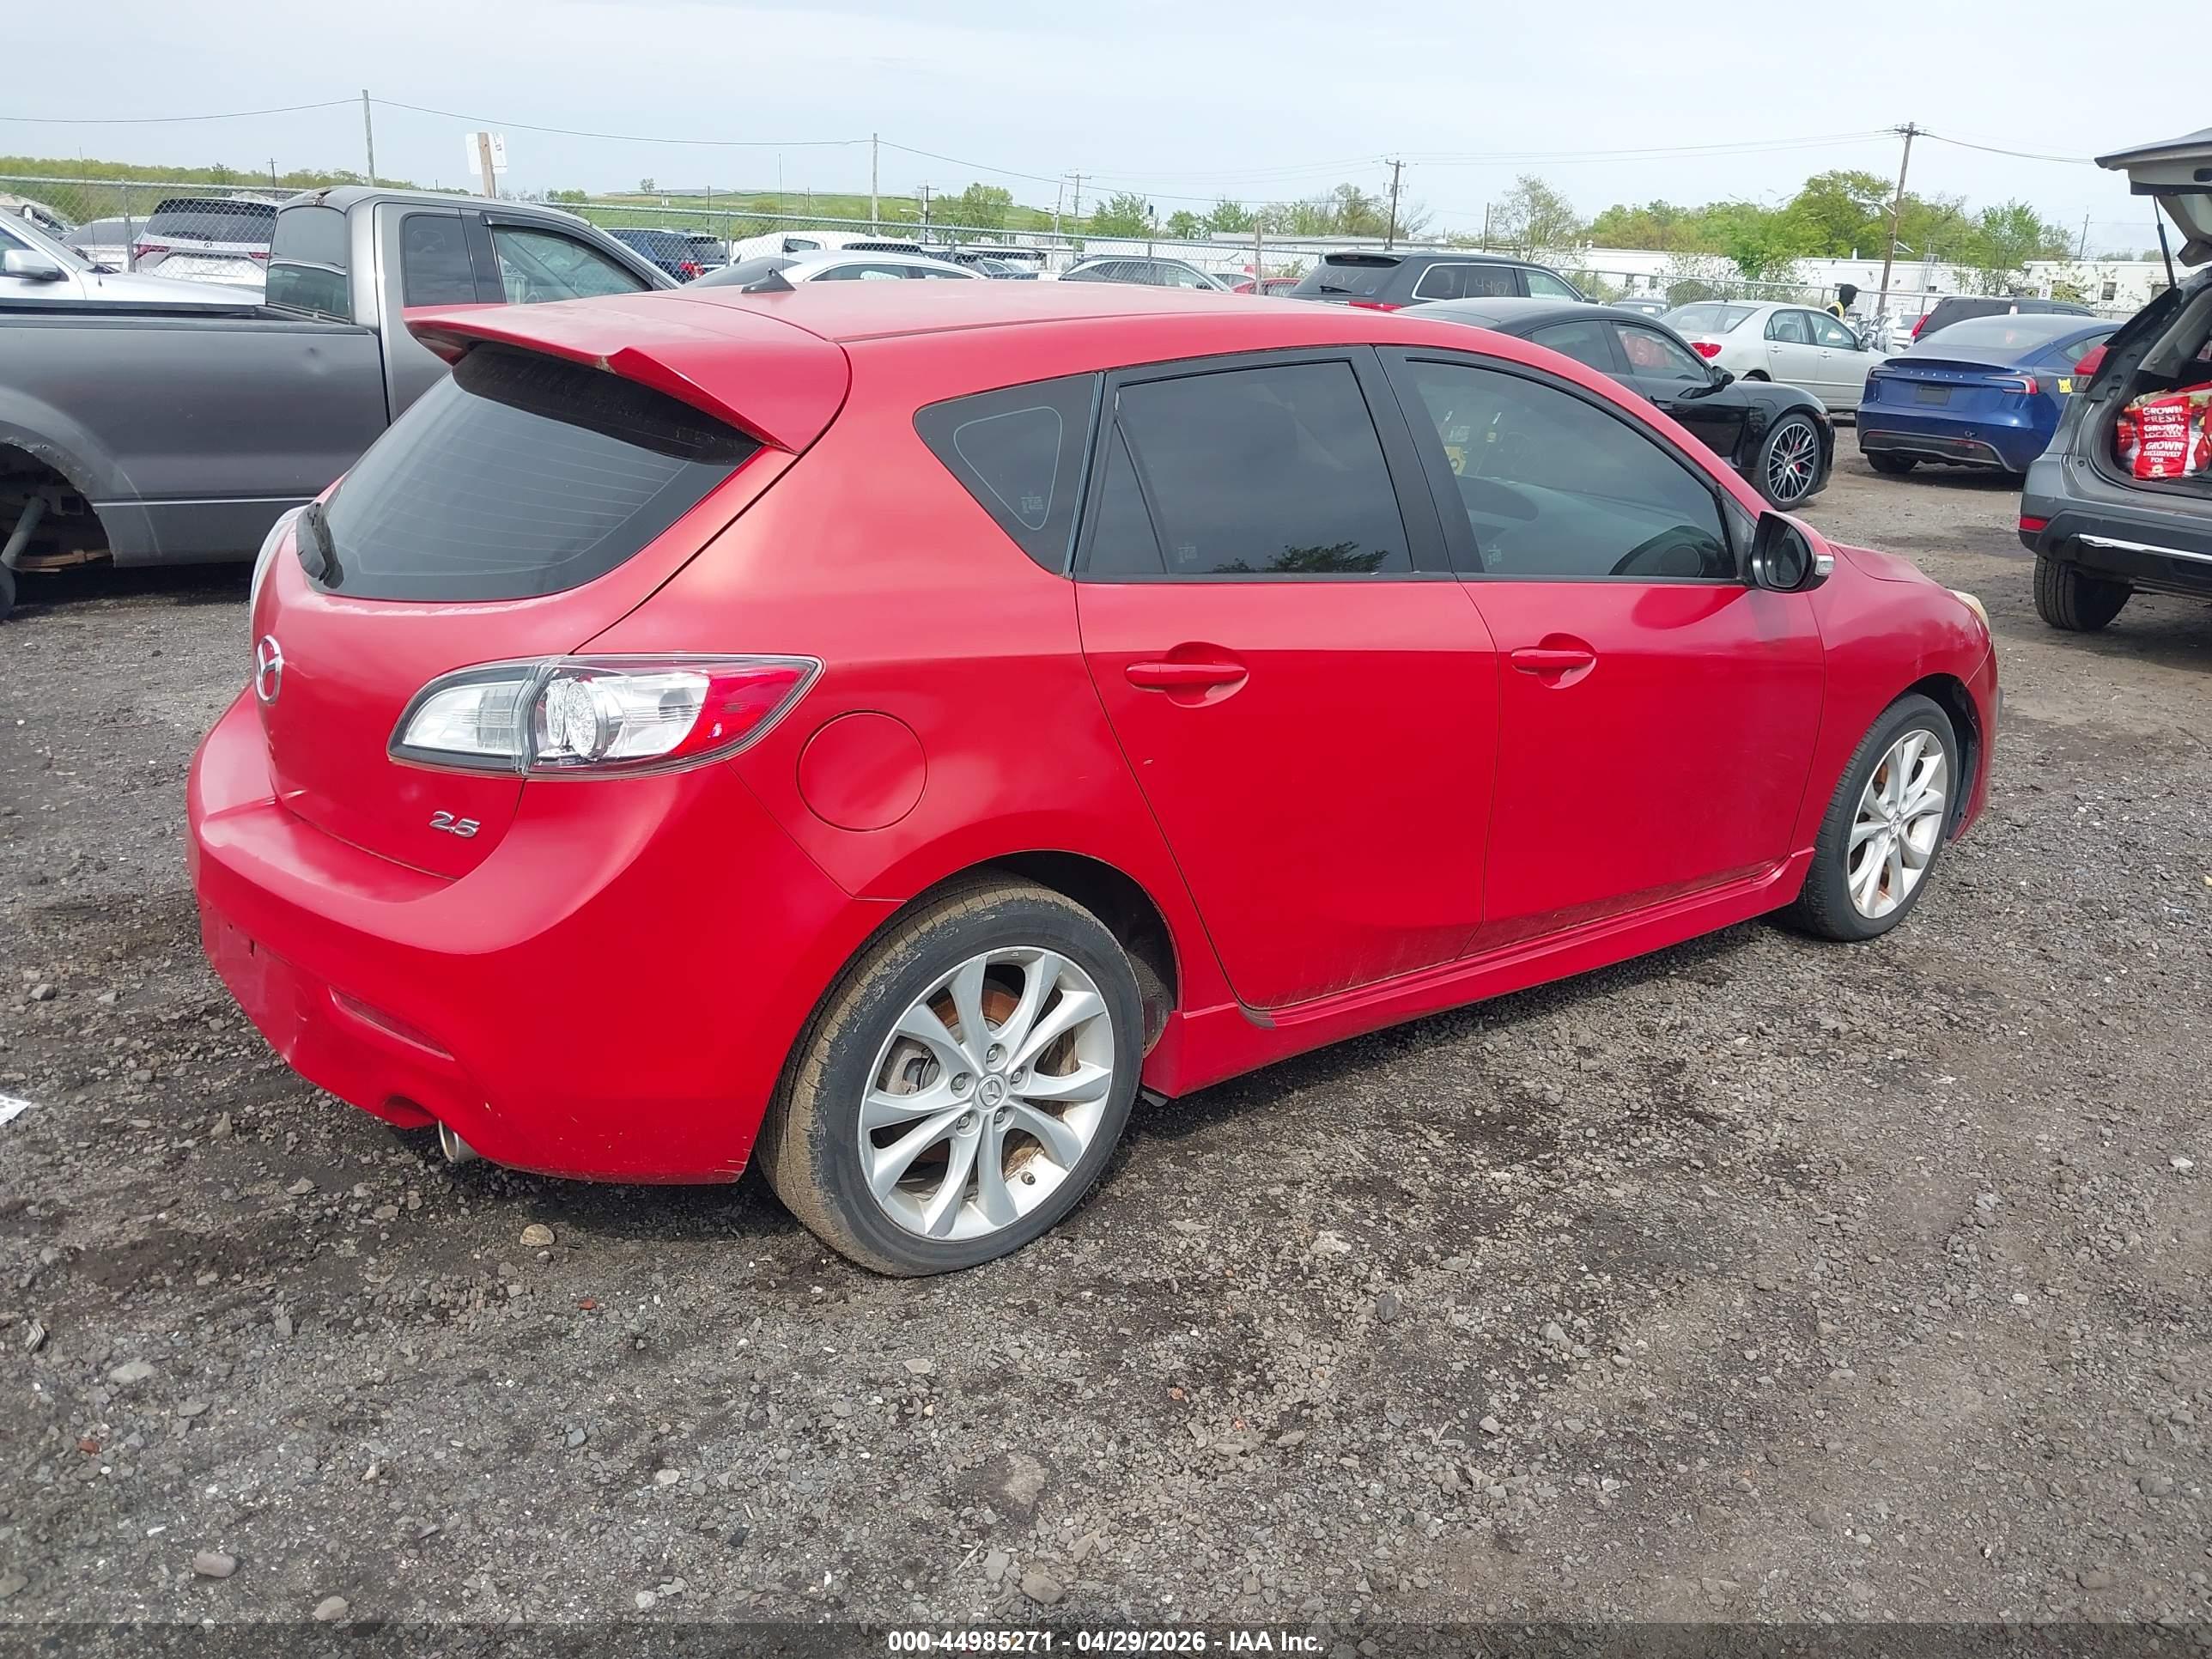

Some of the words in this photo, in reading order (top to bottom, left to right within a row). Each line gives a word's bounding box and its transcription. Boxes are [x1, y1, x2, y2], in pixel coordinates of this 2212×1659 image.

[2142, 405, 2184, 416] GROWN
[2143, 424, 2185, 433] GROWN
[2145, 441, 2185, 451] GROWN
[429, 811, 481, 838] 2.5
